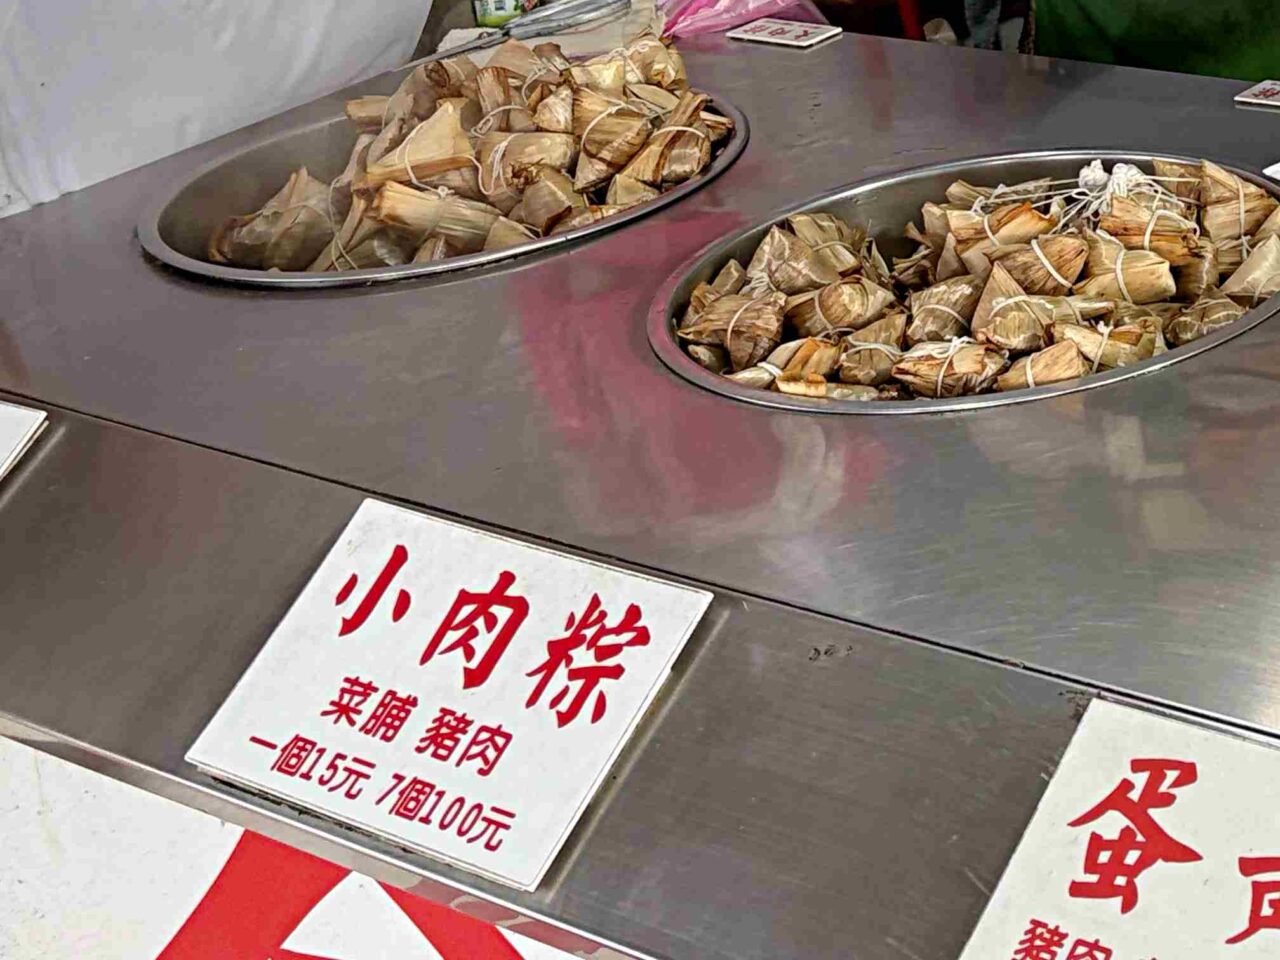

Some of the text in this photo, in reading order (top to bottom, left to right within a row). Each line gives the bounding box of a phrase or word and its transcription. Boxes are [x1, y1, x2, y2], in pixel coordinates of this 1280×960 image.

[335, 544, 651, 729] 小肉粽
[320, 676, 513, 777] 菜脯 豬肉
[249, 734, 517, 853] 一個15元 7個100元
